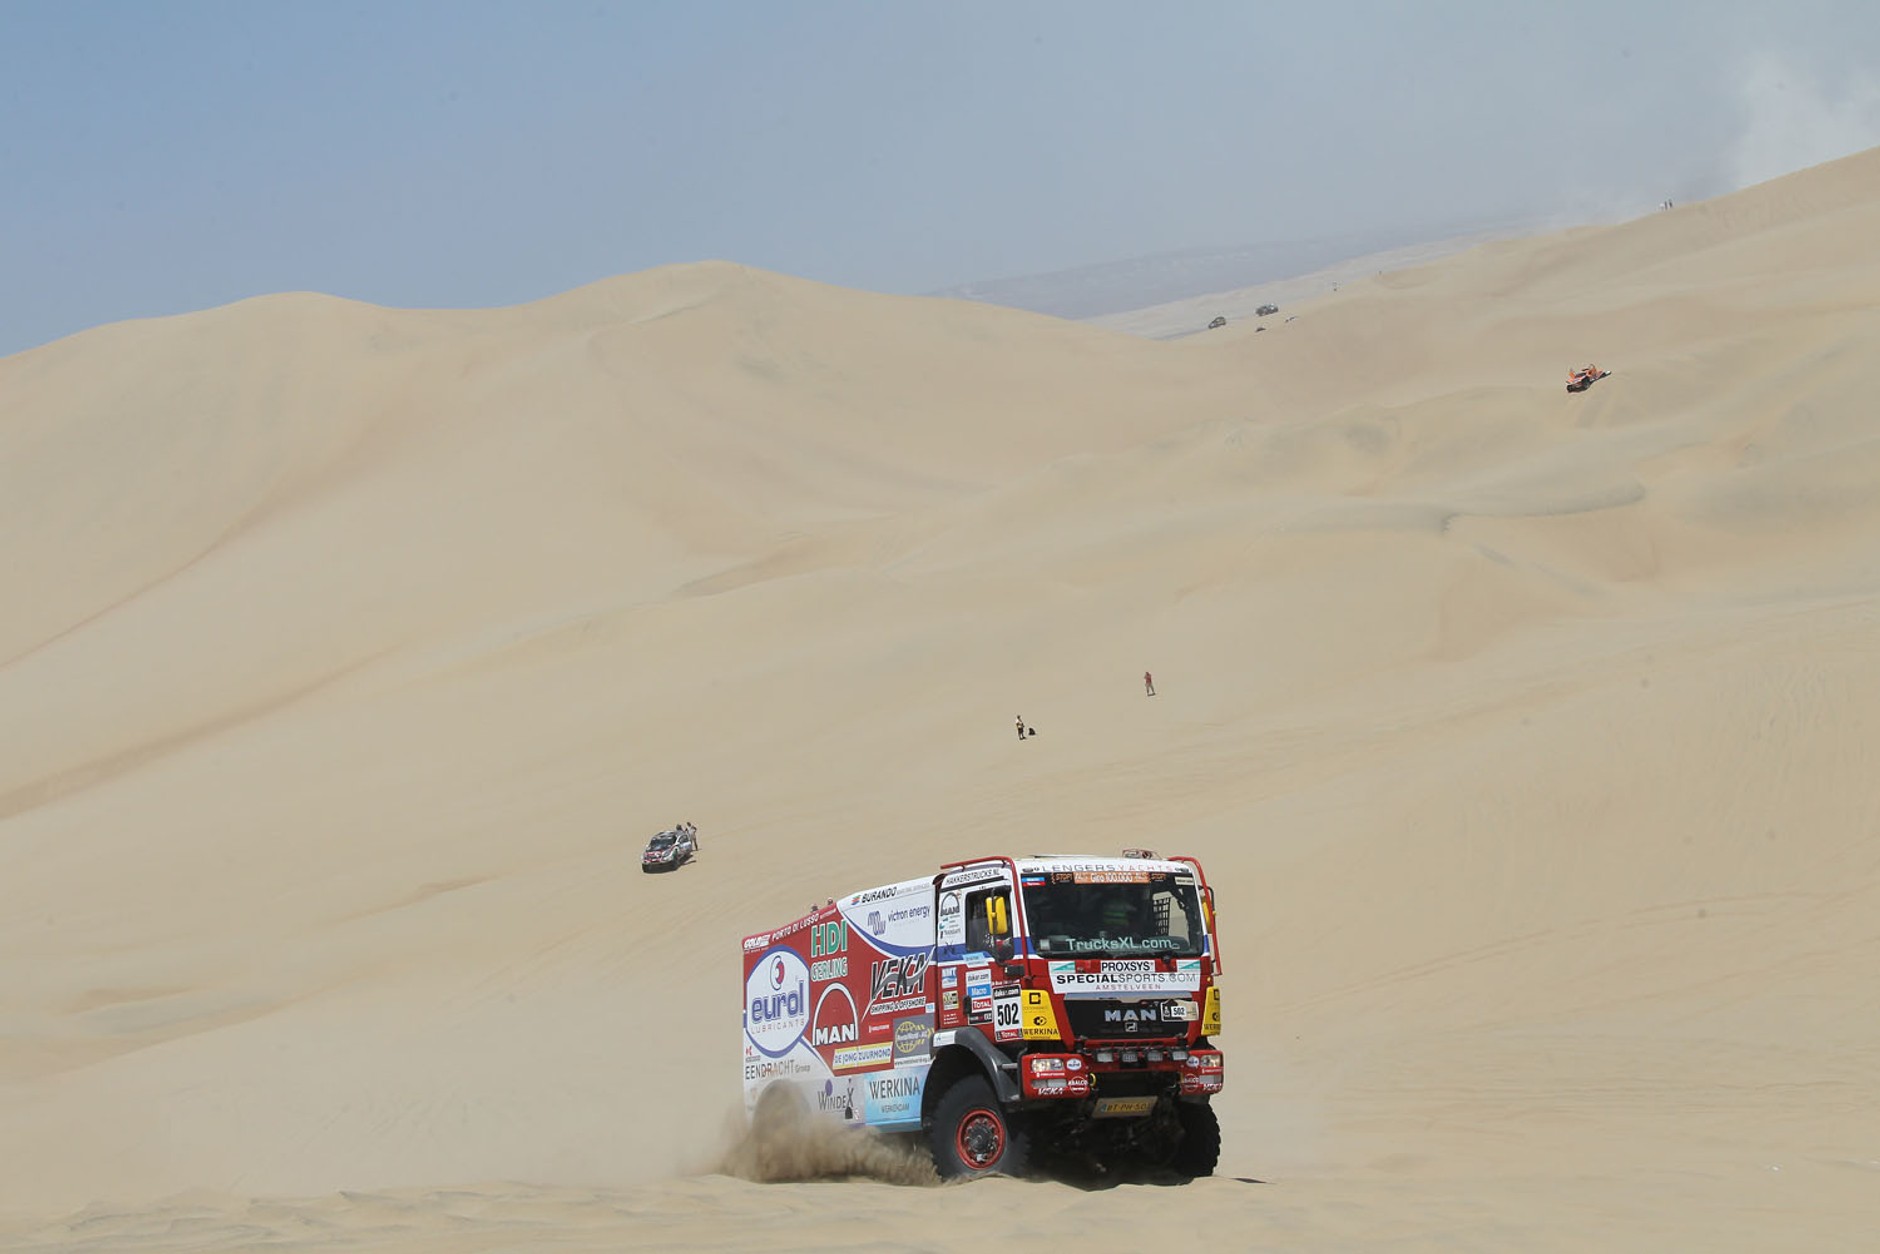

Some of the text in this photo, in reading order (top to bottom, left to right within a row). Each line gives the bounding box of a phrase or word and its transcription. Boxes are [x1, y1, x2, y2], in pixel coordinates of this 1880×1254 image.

[862, 887, 898, 903] BURANDO
[888, 905, 931, 922] victron energy
[772, 926, 792, 941] PORTO
[800, 914, 820, 929] LUSSO
[811, 919, 848, 958] HDI
[1066, 936, 1172, 951] TrucksXL.com
[810, 957, 848, 982] GERLING
[1101, 961, 1149, 972] PROXSYS
[871, 953, 926, 1000] VEKA
[995, 988, 1019, 997] dakar.com
[1096, 983, 1161, 991] AMSTELVEEN
[752, 980, 804, 1024] eurol
[997, 1003, 1019, 1026] 502
[1105, 1009, 1157, 1022] MAN
[1173, 1006, 1185, 1015] 502
[751, 1018, 805, 1034] LUBRICANTS
[815, 1023, 855, 1045] MAN
[1023, 1028, 1059, 1036] WERKINA
[860, 1048, 891, 1061] ZUURMOND
[745, 1060, 795, 1079] EENDRACHT
[869, 1077, 921, 1100] WERKINA
